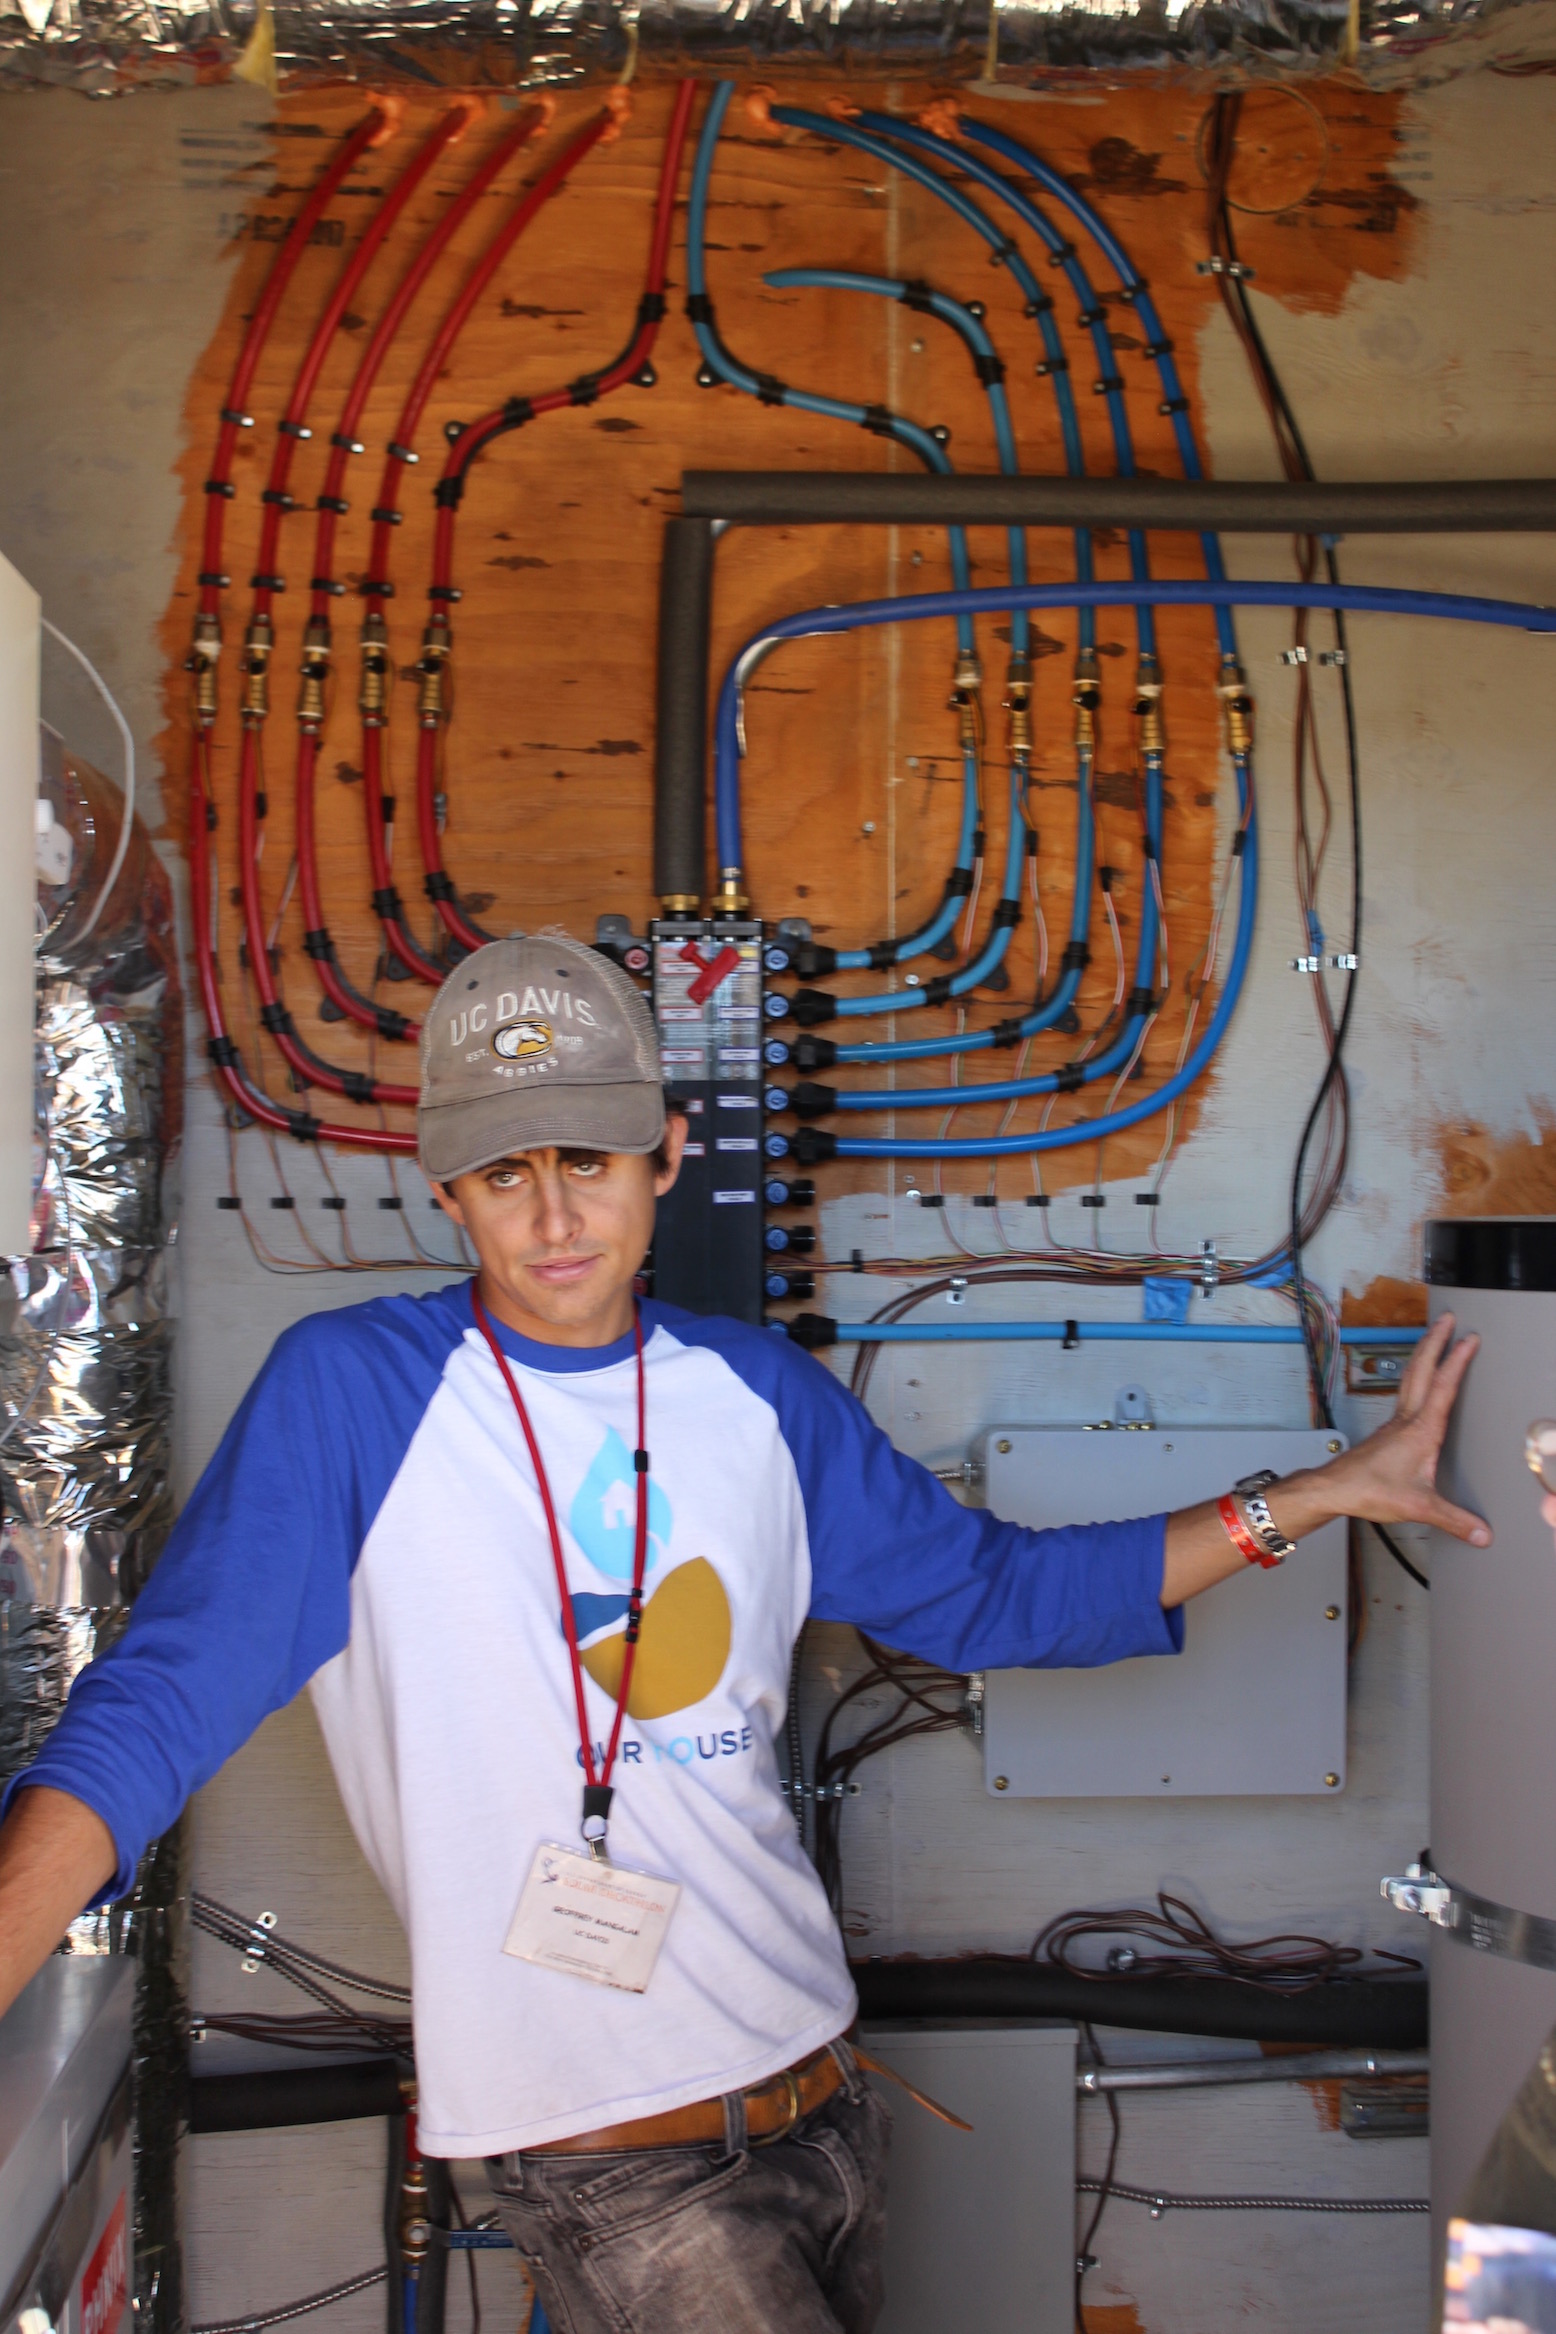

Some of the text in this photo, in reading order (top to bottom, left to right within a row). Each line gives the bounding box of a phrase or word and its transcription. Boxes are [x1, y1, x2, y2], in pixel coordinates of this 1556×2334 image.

[450, 986, 600, 1046] UC DAVIS
[492, 1057, 559, 1078] AGGIES
[576, 1740, 642, 1769] OUR
